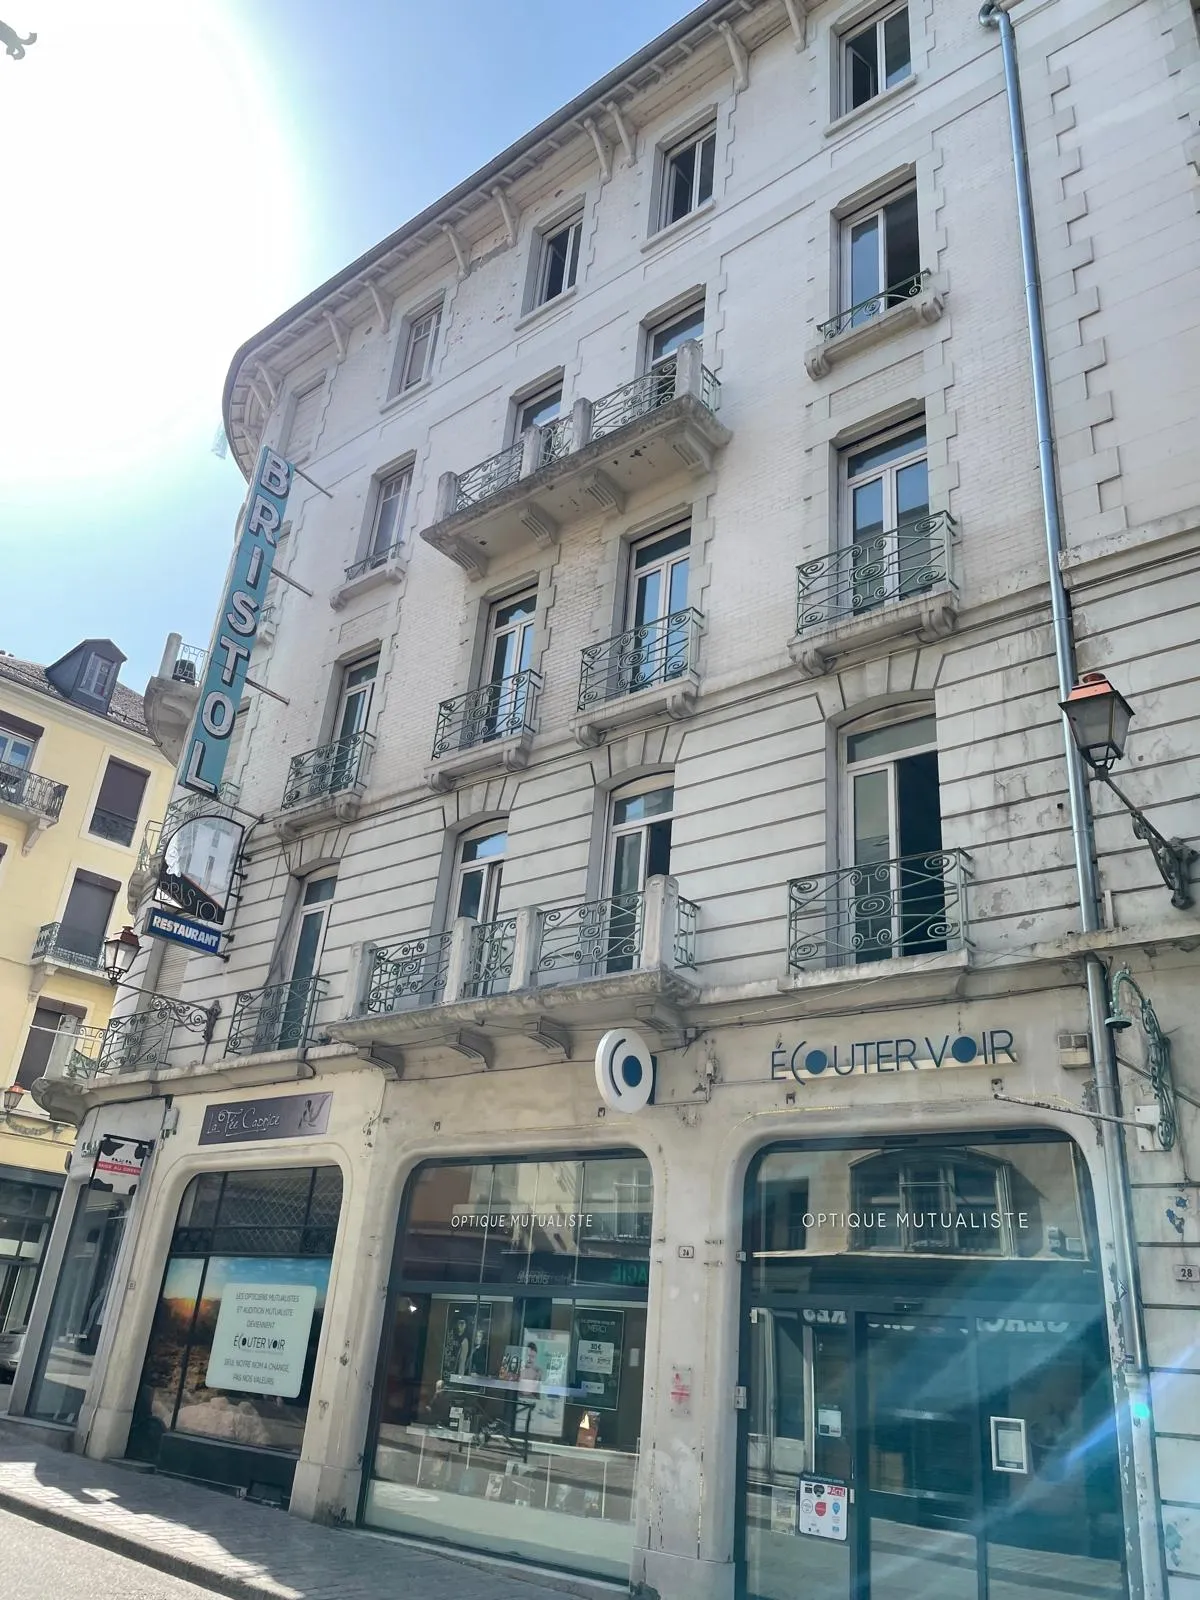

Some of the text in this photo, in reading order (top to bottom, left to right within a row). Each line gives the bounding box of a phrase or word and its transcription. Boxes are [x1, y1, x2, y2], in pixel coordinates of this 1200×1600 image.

[184, 449, 291, 795] BRISTOL
[160, 876, 222, 924] BRISTOL
[152, 915, 219, 947] RESTAURANT
[925, 1029, 1018, 1068] VOIR
[451, 1214, 593, 1228] OPTIQUE MUTUALISTE
[802, 1212, 1029, 1228] OPTIQUE MUTUALISTE
[1180, 1268, 1193, 1278] 28
[268, 1293, 300, 1303] MUTUALISTES
[243, 1306, 265, 1315] AUDITION
[264, 1307, 294, 1317] MUTUALISTE
[267, 1337, 286, 1351] VOIR
